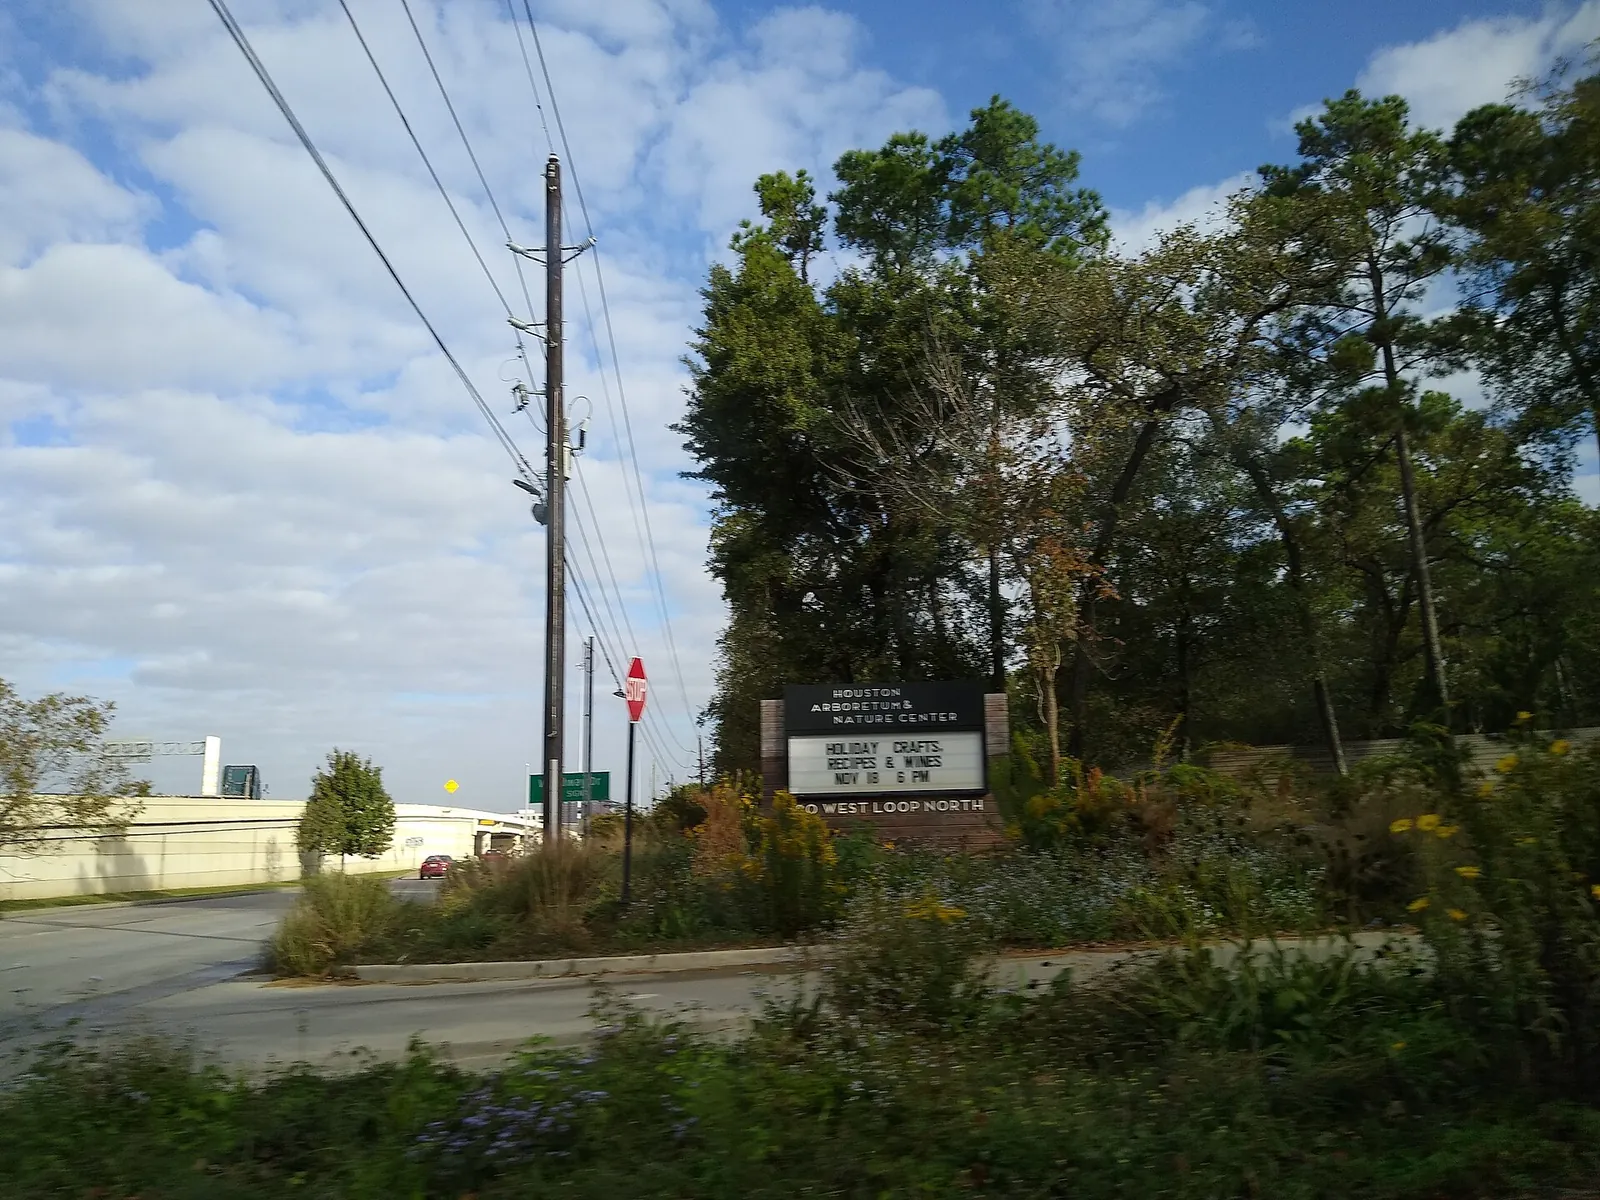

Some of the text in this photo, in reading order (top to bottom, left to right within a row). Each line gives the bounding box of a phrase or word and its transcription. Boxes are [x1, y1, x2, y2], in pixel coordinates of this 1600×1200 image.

[833, 688, 901, 698] HOUSTON
[833, 712, 958, 724] NATURE CENTER
[825, 742, 880, 755] HOLIDAY
[827, 755, 943, 770] RECIPES & WINES
[834, 770, 931, 785] NOV 18 6 PM
[822, 802, 869, 815] WEST
[872, 801, 920, 813] LOOP
[923, 799, 985, 812] NORTH
